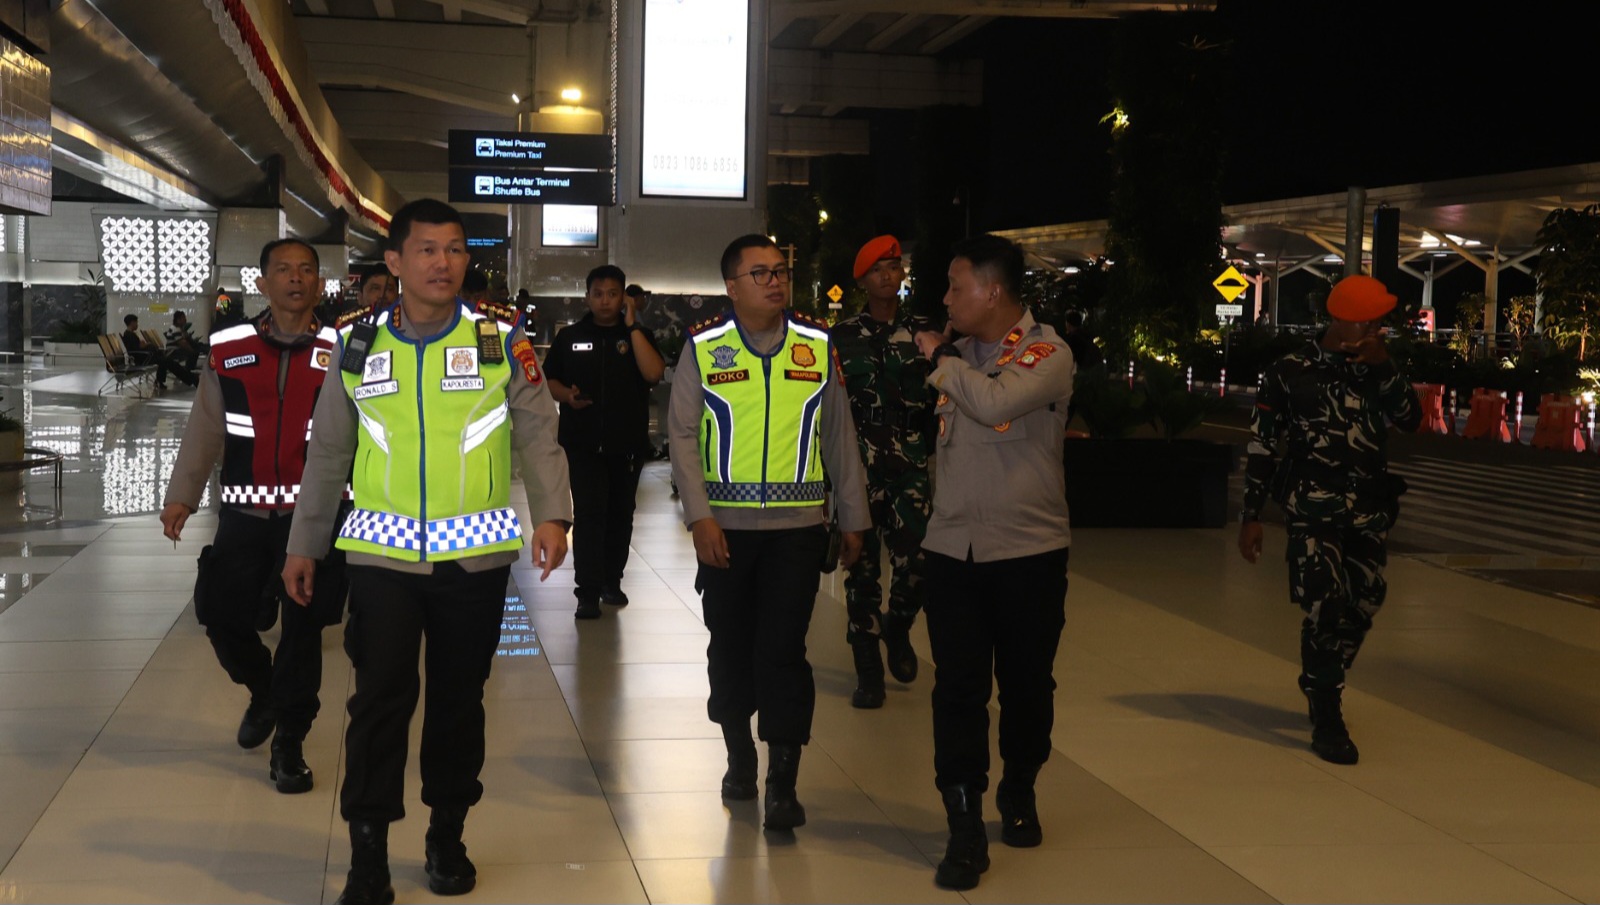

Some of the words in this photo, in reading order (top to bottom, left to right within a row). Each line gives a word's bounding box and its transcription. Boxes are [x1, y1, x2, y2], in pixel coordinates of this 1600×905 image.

[495, 139, 513, 147] Taksi
[515, 140, 546, 149] Premium
[495, 150, 526, 159] Premium
[528, 151, 542, 159] Taxi
[653, 155, 678, 170] 0823
[684, 156, 708, 171] 1086
[713, 157, 738, 172] 6856
[495, 177, 511, 185] Bus
[512, 177, 535, 186] Antar
[535, 178, 570, 187] Terminal
[495, 187, 523, 196] Shuttle
[525, 188, 541, 196] Bus
[711, 371, 745, 383] JOKO
[442, 380, 482, 389] KAPOLRESTA
[356, 385, 387, 397] RONALD
